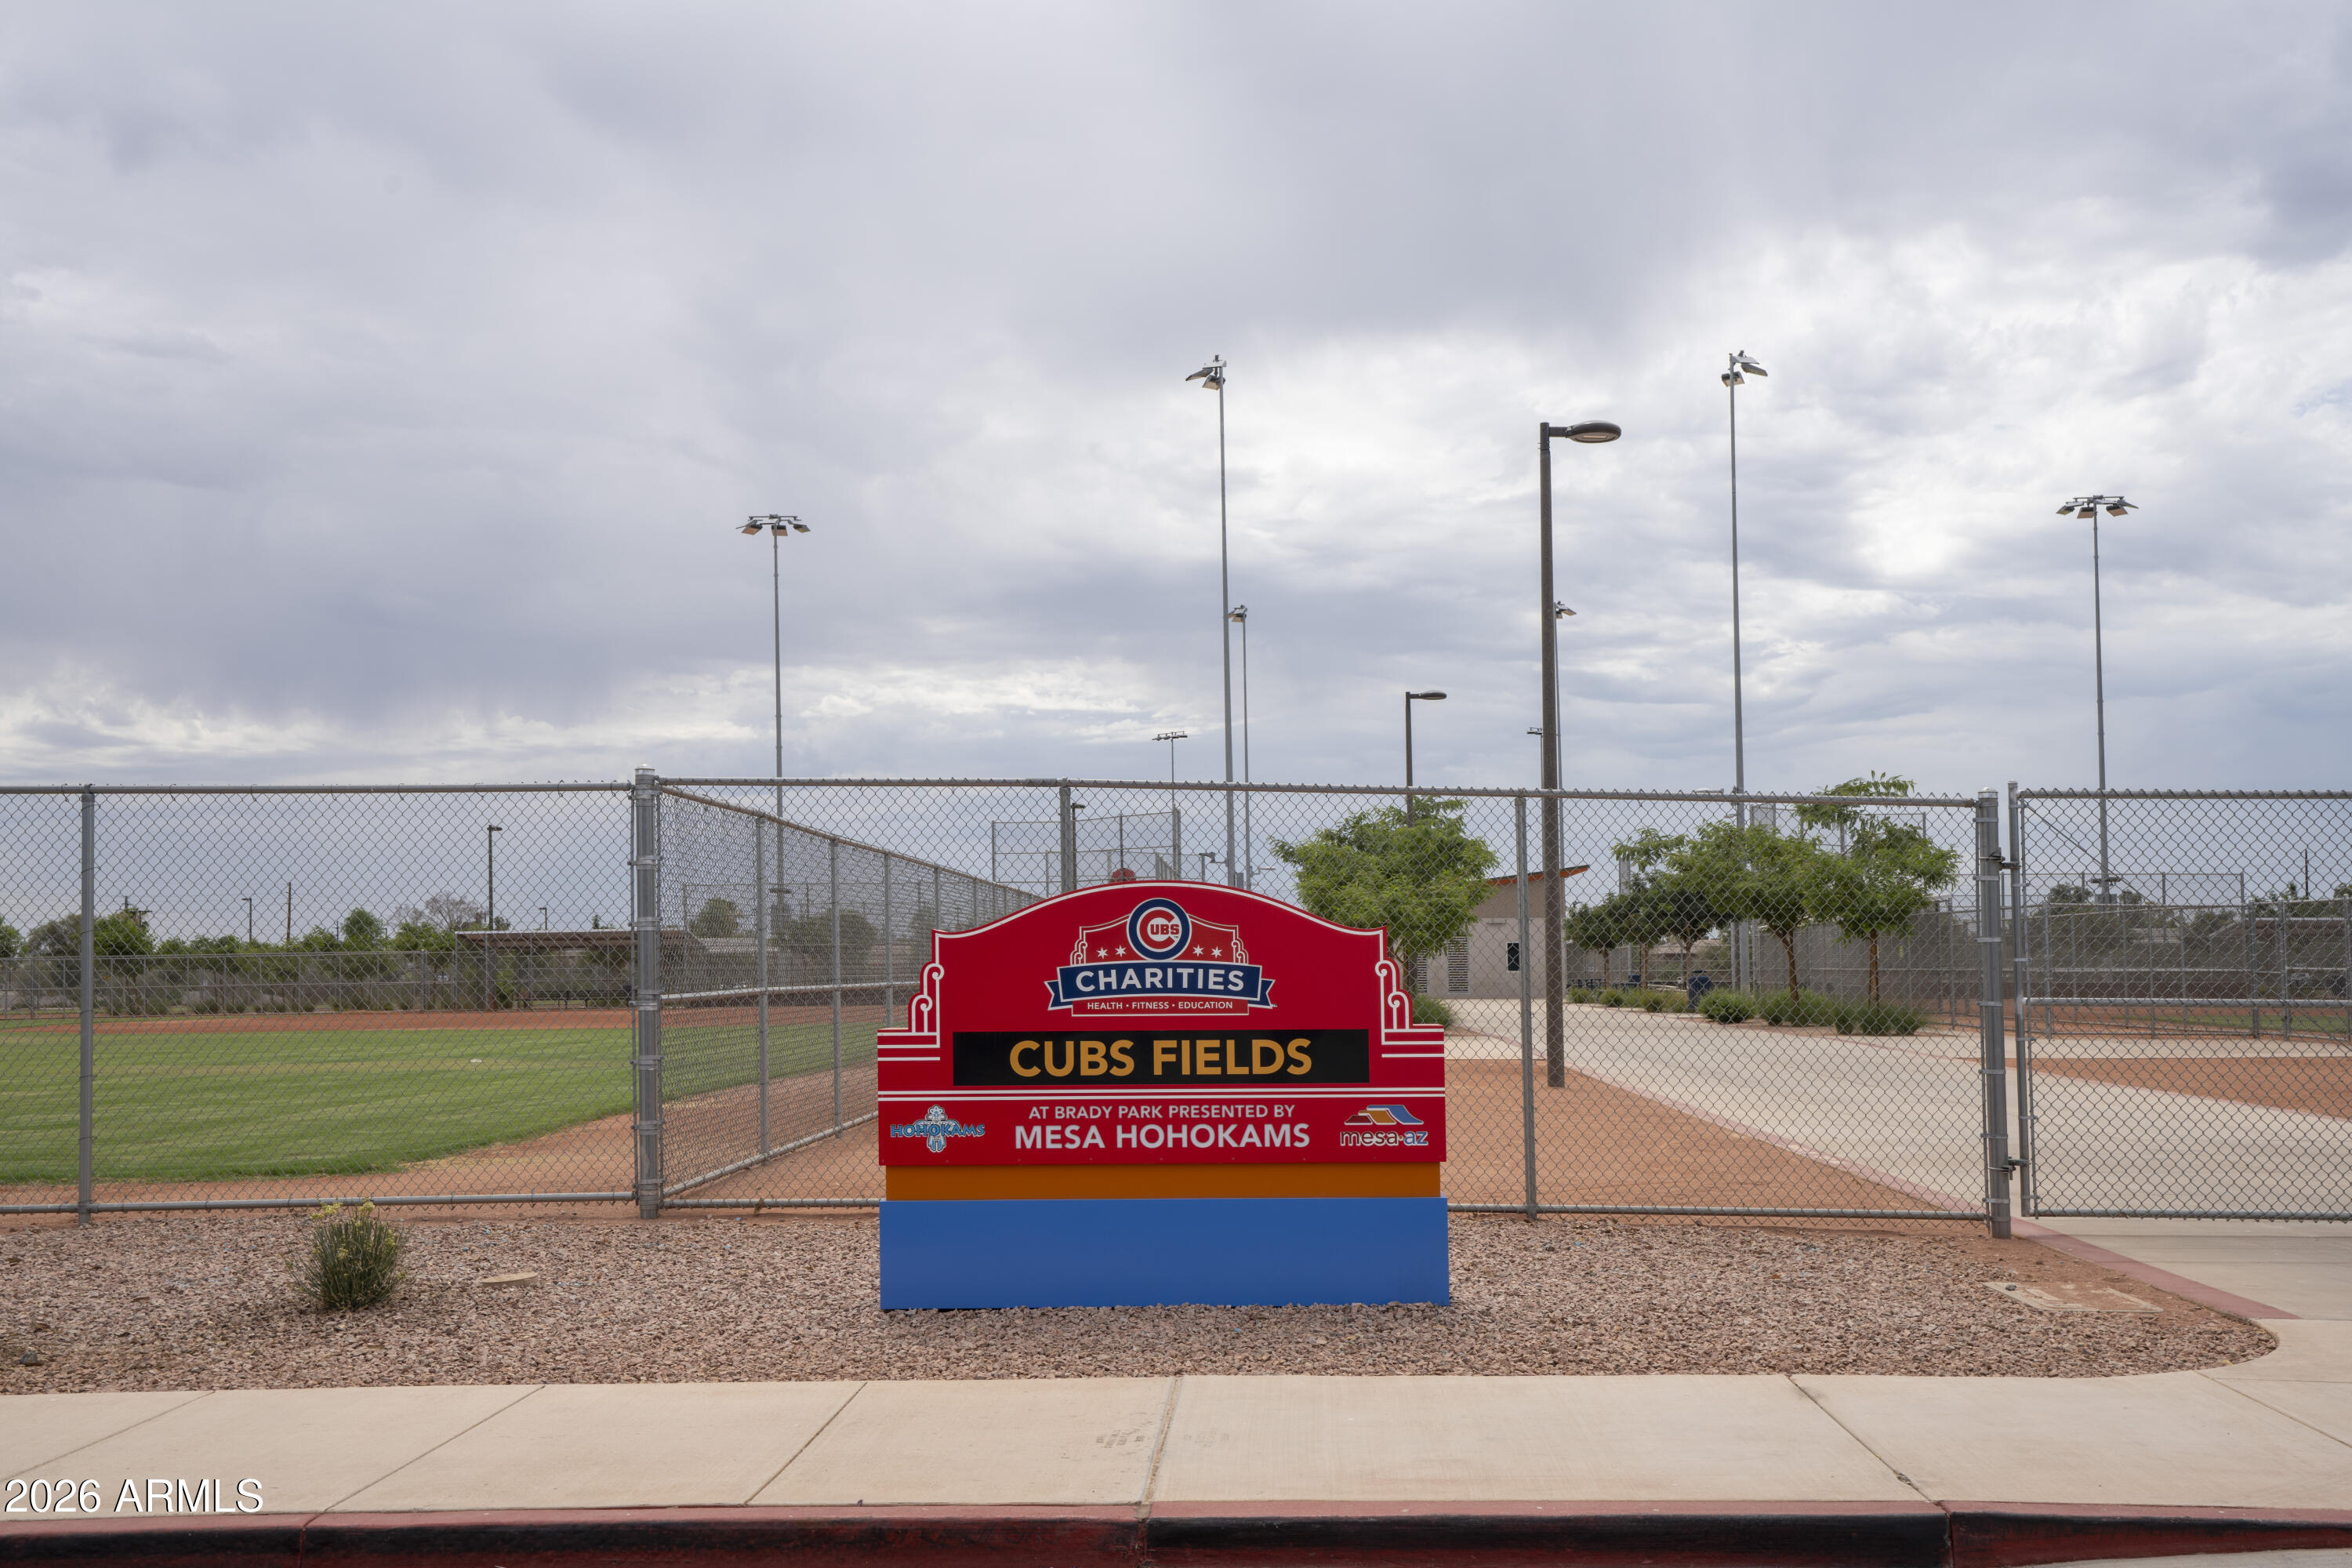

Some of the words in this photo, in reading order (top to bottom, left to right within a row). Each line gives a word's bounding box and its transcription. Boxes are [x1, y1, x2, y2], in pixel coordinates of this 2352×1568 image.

[1139, 909, 1180, 950] CUBS
[1076, 967, 1245, 992] CHARITIES
[1178, 1001, 1233, 1010] EDUCATION
[1009, 1039, 1135, 1077] CUBS
[1152, 1038, 1312, 1076] FIELDS
[1029, 1106, 1050, 1119] AT
[1054, 1105, 1112, 1119] BRADY
[1118, 1105, 1163, 1119] PARK
[1169, 1105, 1268, 1118] PRESENTED
[1275, 1105, 1295, 1117] BY
[891, 1123, 985, 1137] HOHOKAMS
[1015, 1124, 1105, 1149] MESA
[1116, 1123, 1310, 1149] HOHOKAMS
